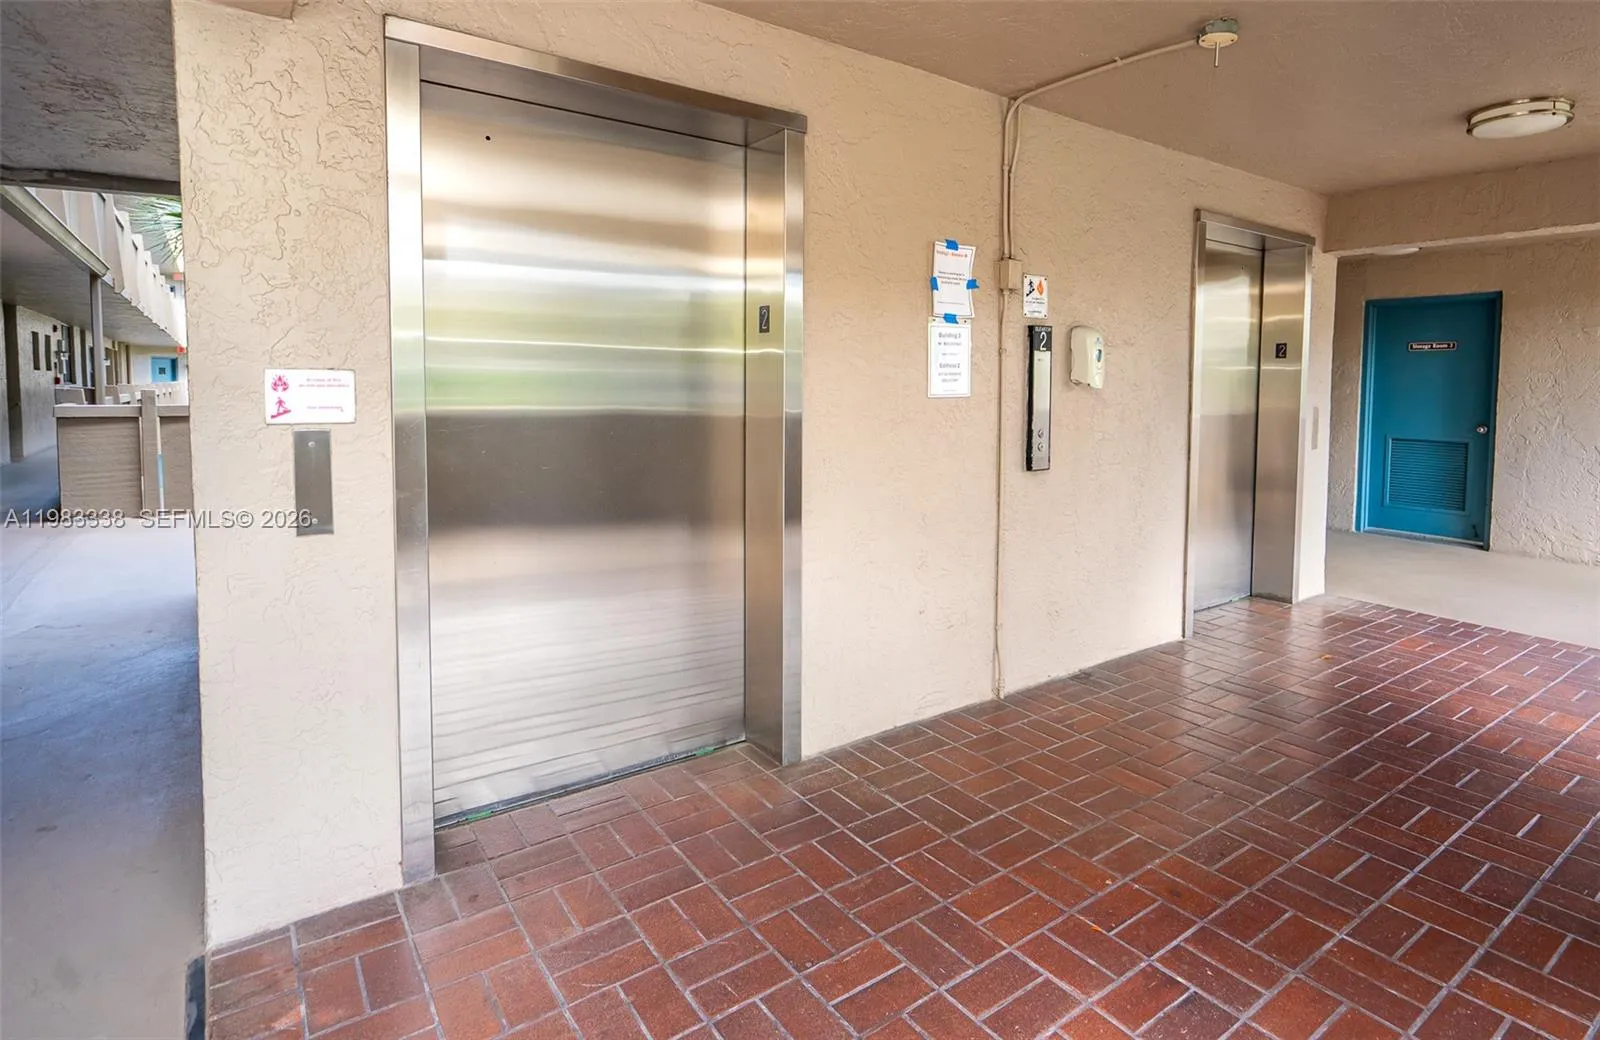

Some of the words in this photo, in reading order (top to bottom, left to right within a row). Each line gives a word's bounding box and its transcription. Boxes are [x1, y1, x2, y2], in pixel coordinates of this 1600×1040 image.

[761, 308, 768, 329] 2
[1040, 331, 1047, 350] 2
[1279, 344, 1286, 357] 2
